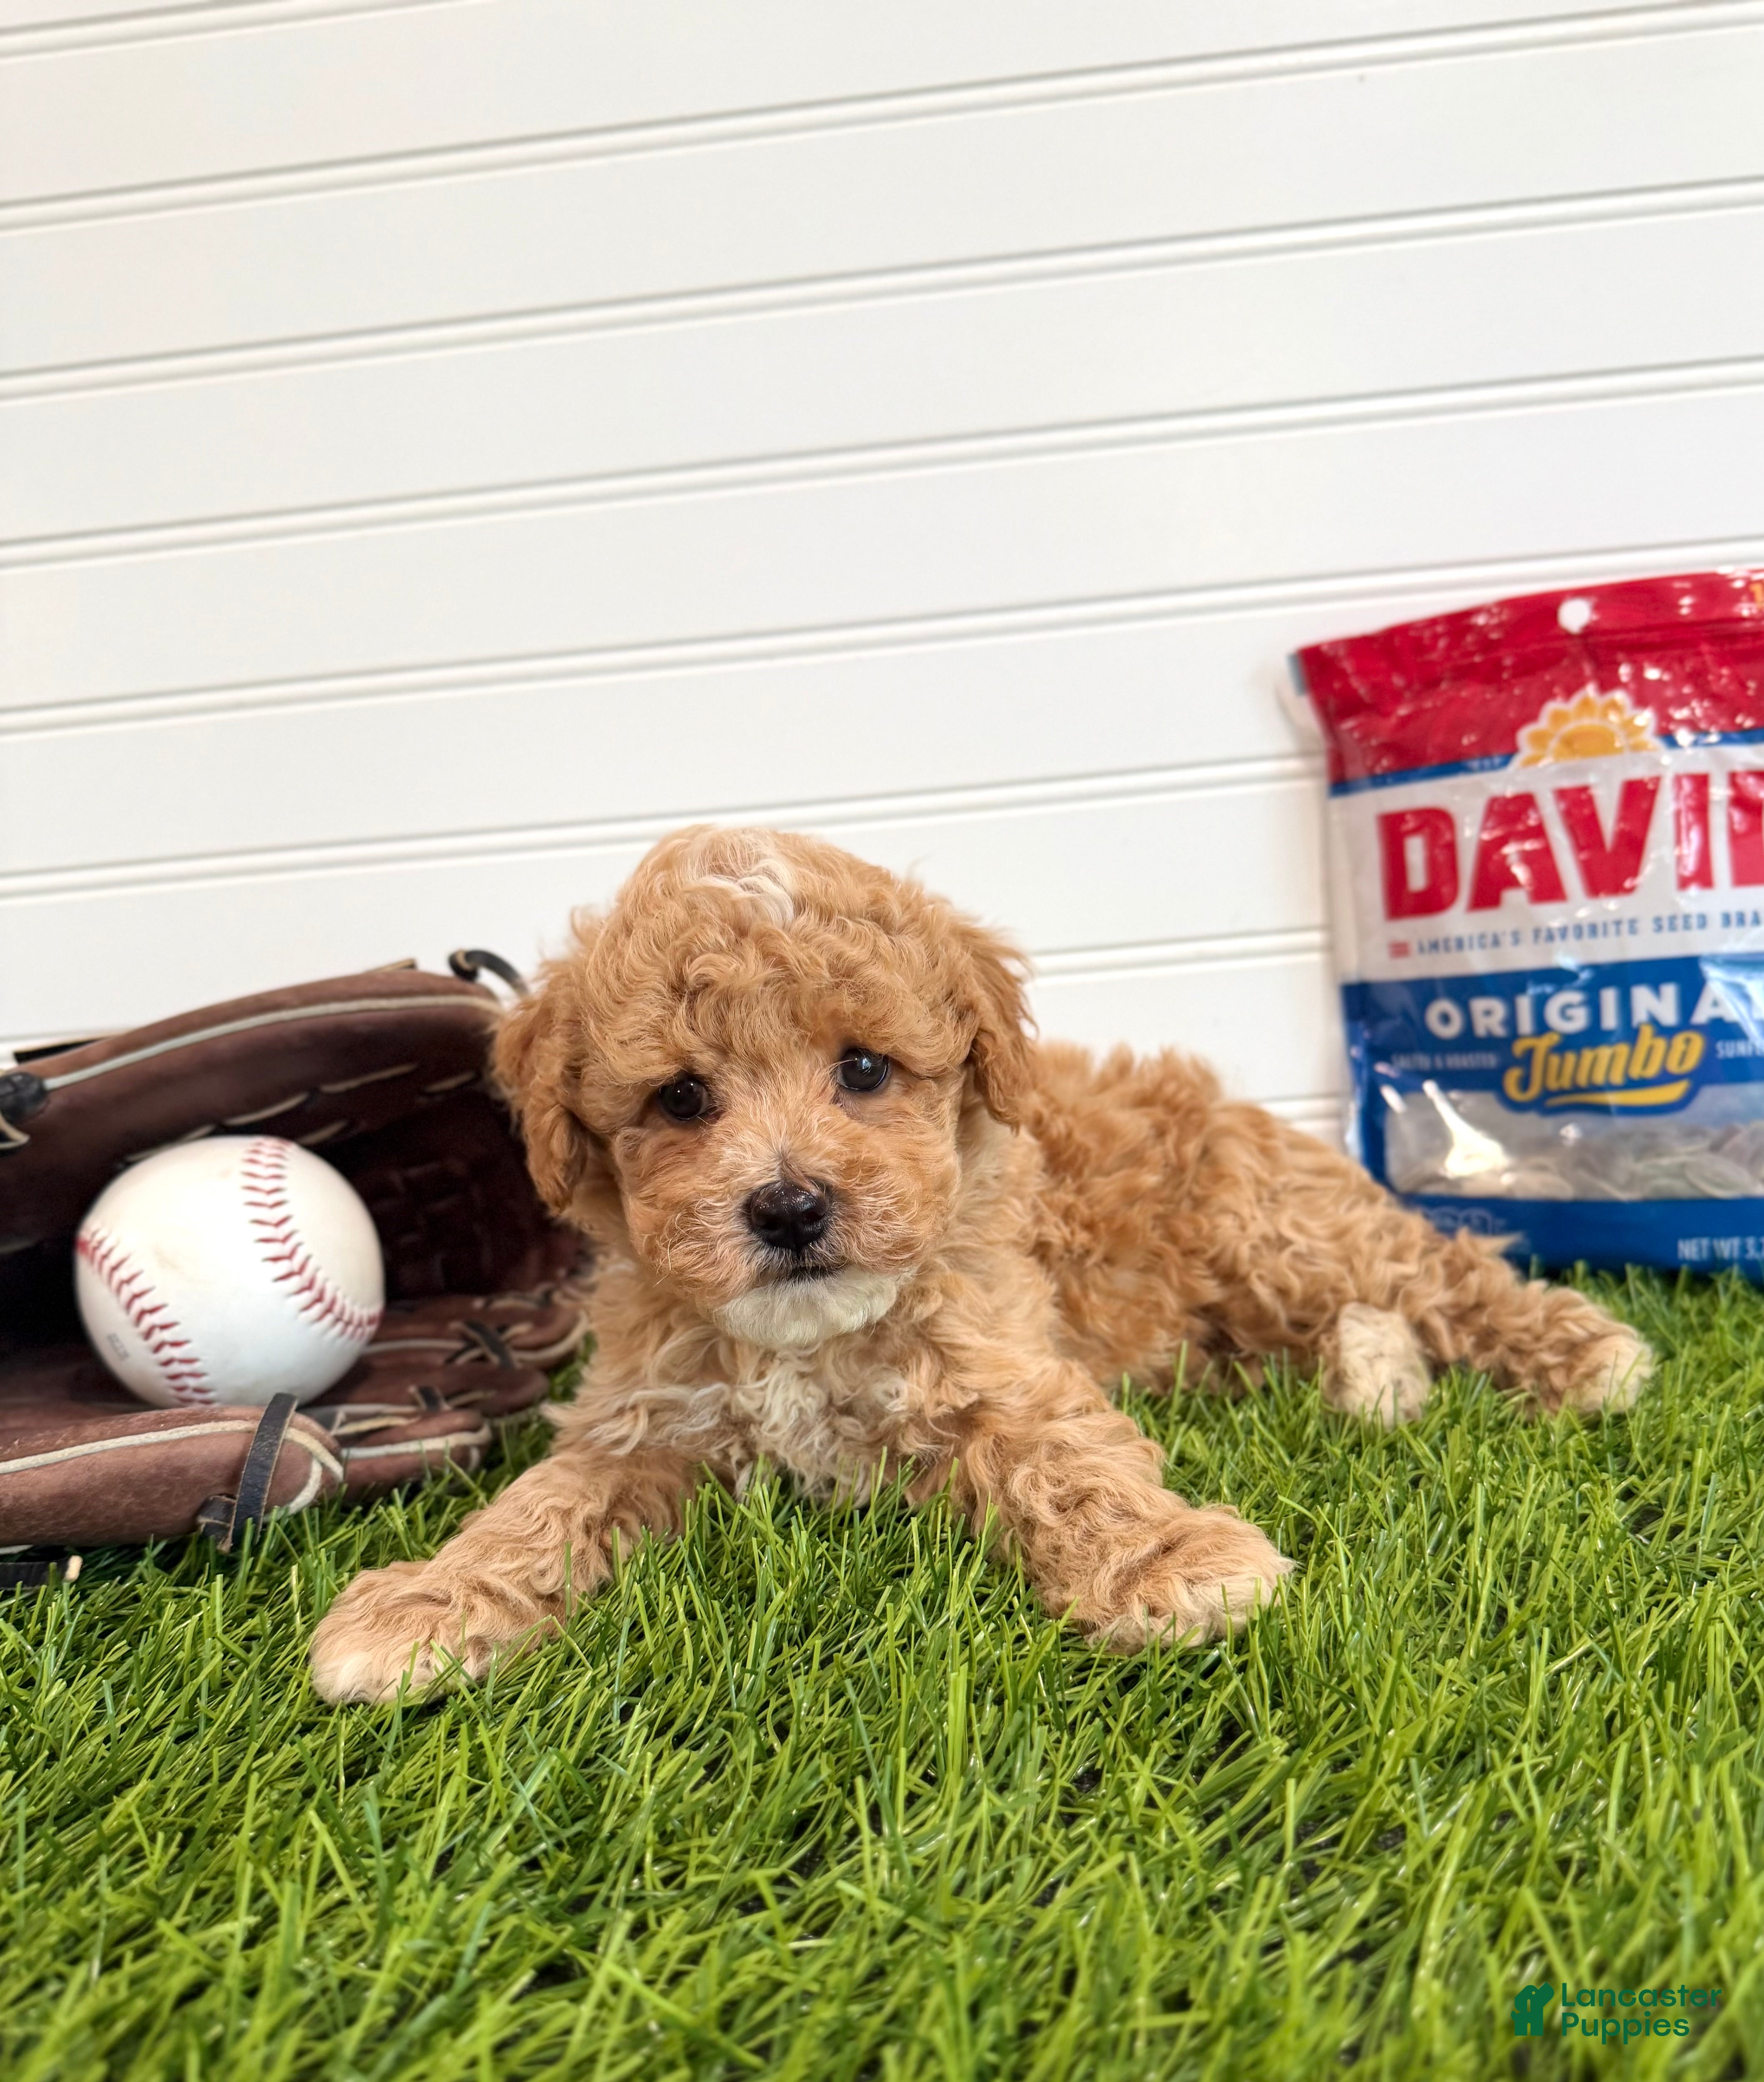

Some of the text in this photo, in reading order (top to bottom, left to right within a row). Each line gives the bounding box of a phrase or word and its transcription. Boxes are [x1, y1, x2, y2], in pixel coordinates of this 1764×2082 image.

[1417, 929, 1521, 955] AMERICA'S
[1532, 918, 1638, 945] FAVORITE
[1652, 913, 1707, 933] SEED
[1503, 1023, 1706, 1102] Jumbo
[1677, 1237, 1709, 1261] NET
[1712, 1236, 1740, 1261] WT
